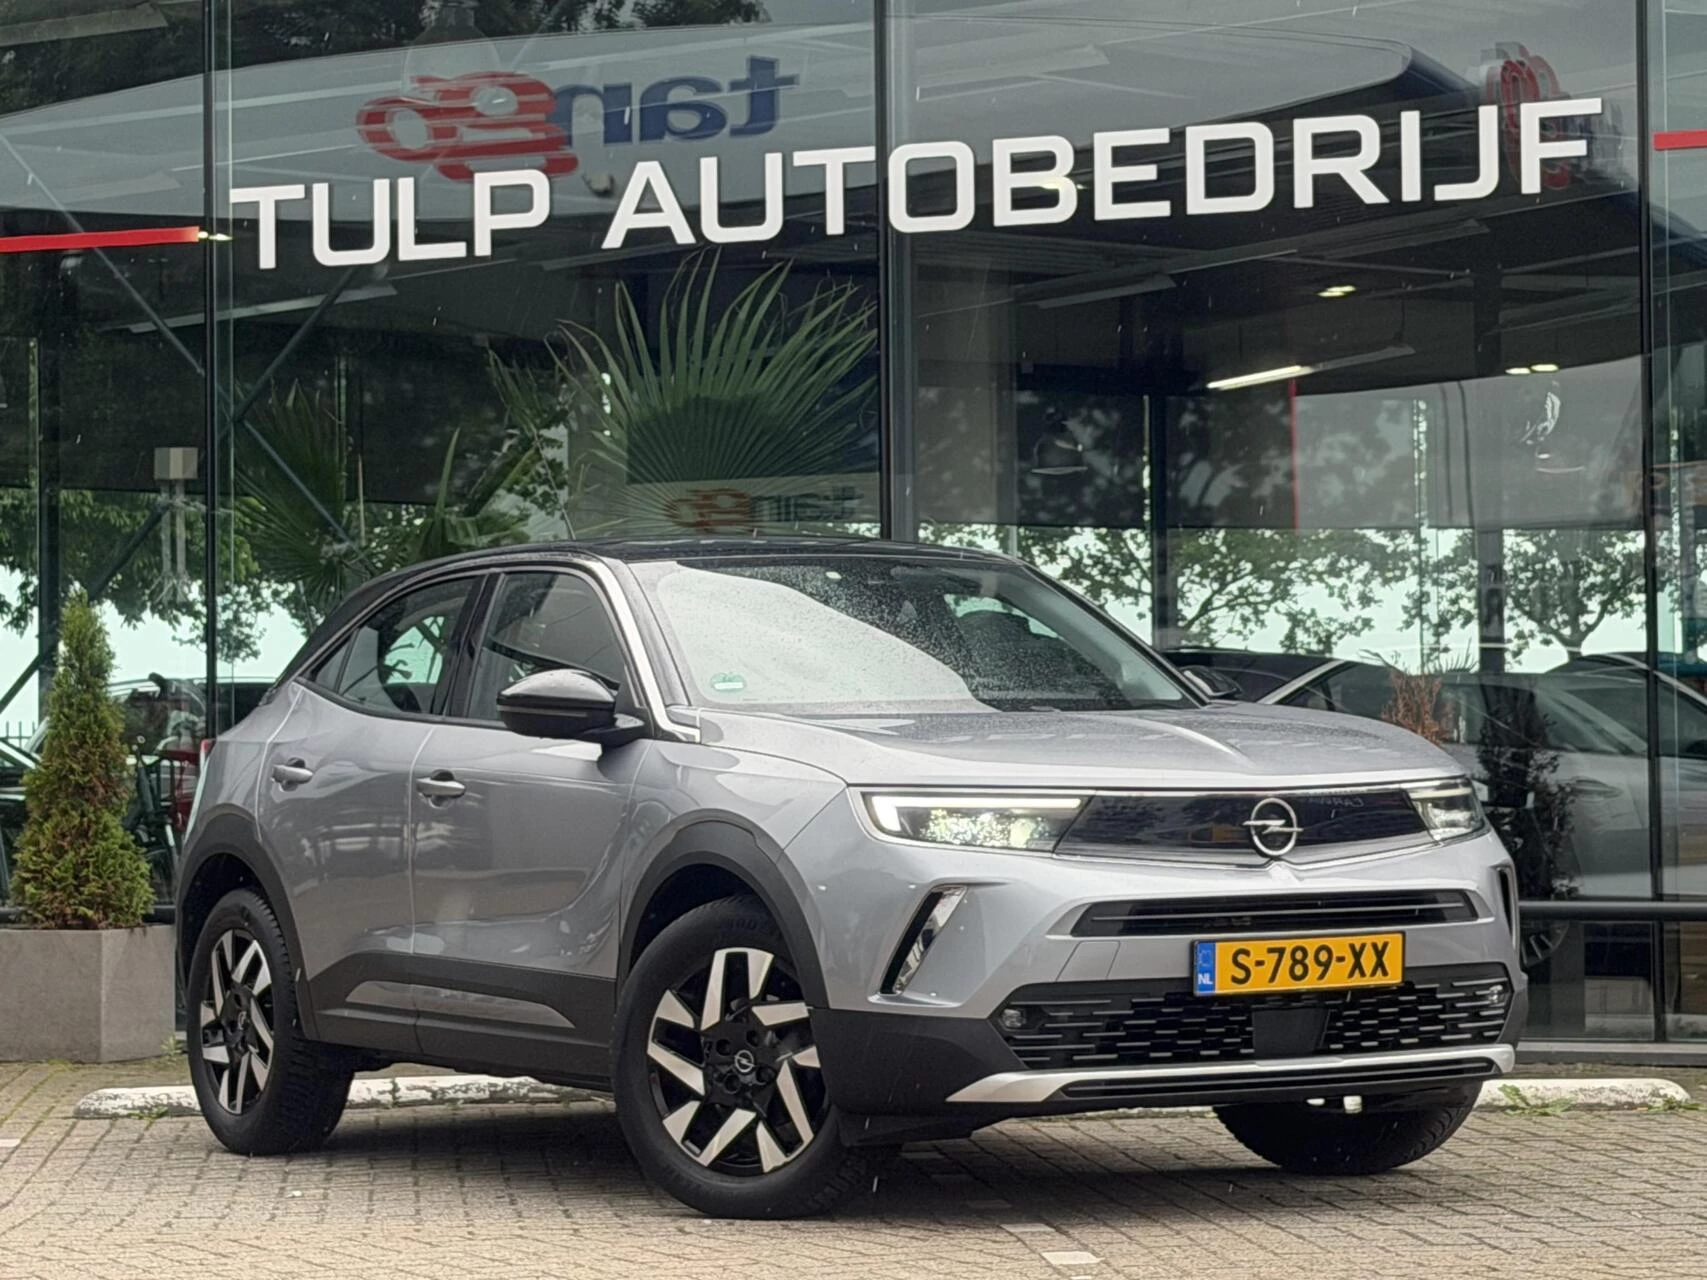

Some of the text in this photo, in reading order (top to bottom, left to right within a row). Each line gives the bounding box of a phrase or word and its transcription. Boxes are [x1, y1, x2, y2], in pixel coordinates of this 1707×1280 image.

[229, 169, 550, 270] TULP
[602, 97, 1602, 250] AUTOBEDRIJF
[1197, 941, 1390, 985] NL S-789-XX
